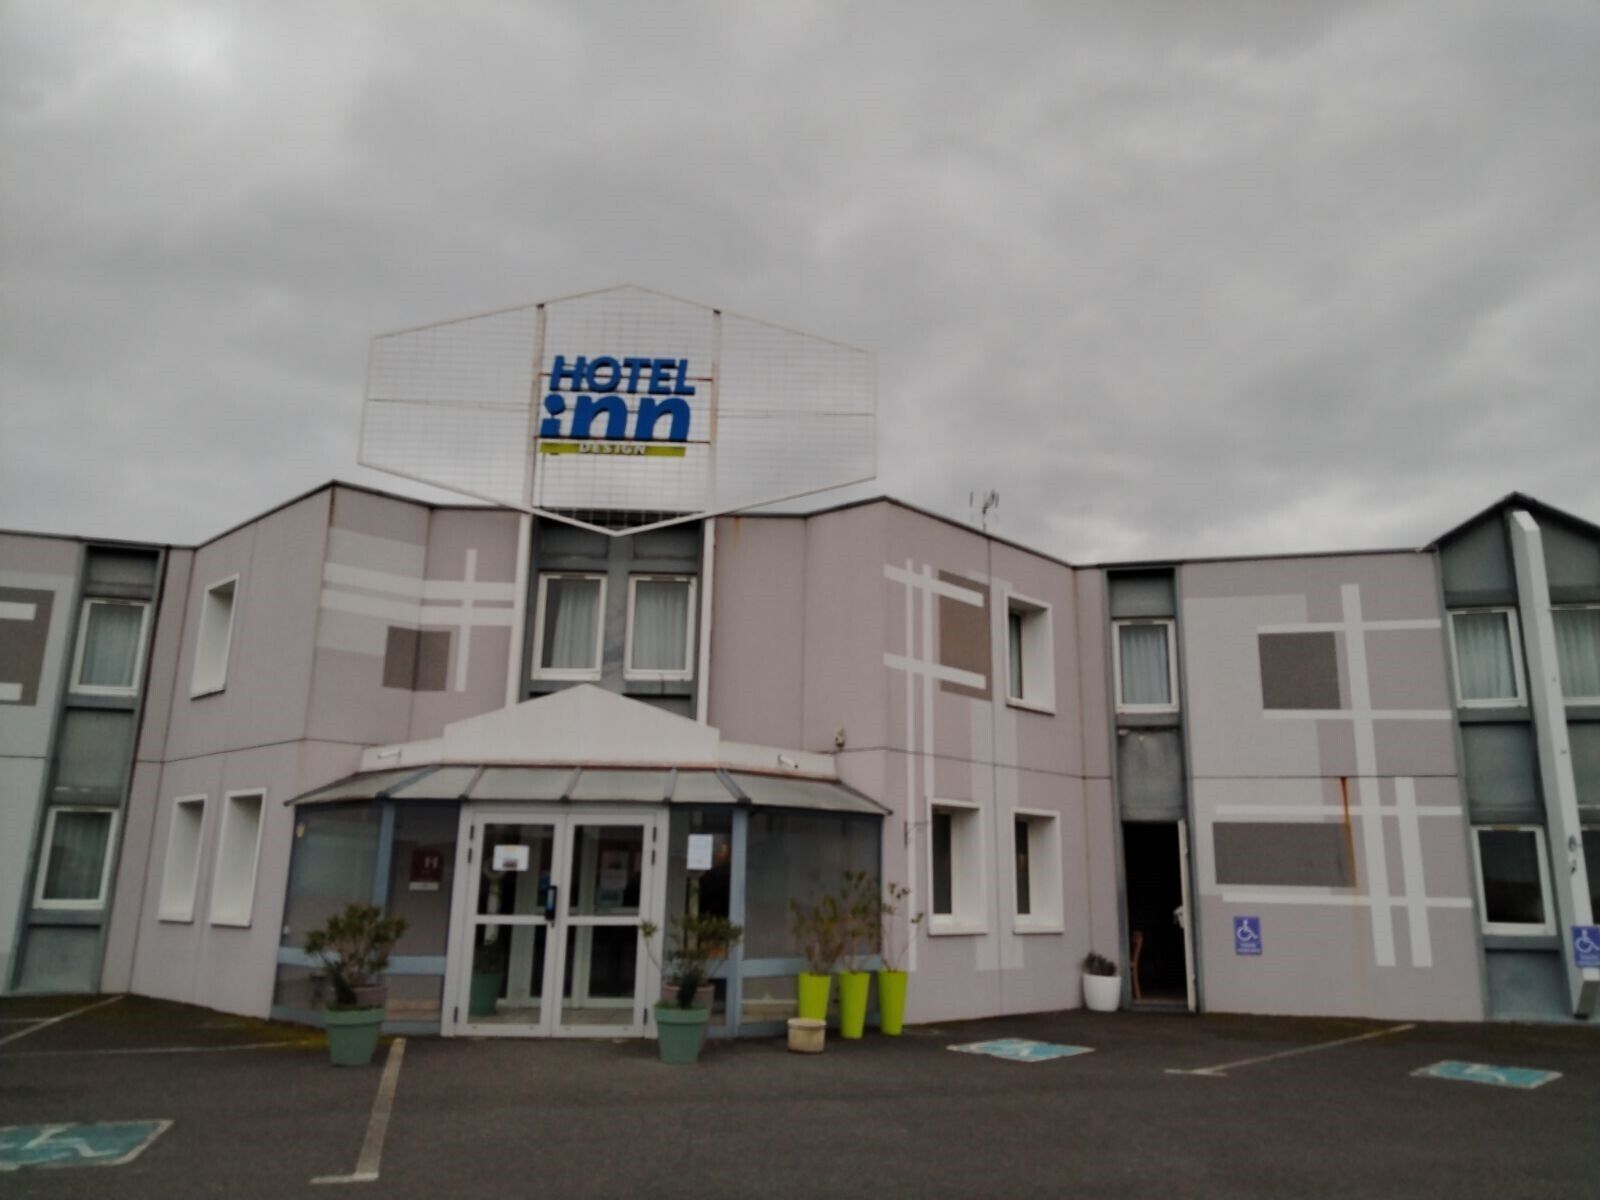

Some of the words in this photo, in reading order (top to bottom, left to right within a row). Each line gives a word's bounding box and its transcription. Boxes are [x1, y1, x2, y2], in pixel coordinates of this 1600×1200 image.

[549, 355, 695, 395] HOTEL
[540, 393, 691, 441] inn
[579, 443, 646, 455] DESIGN
